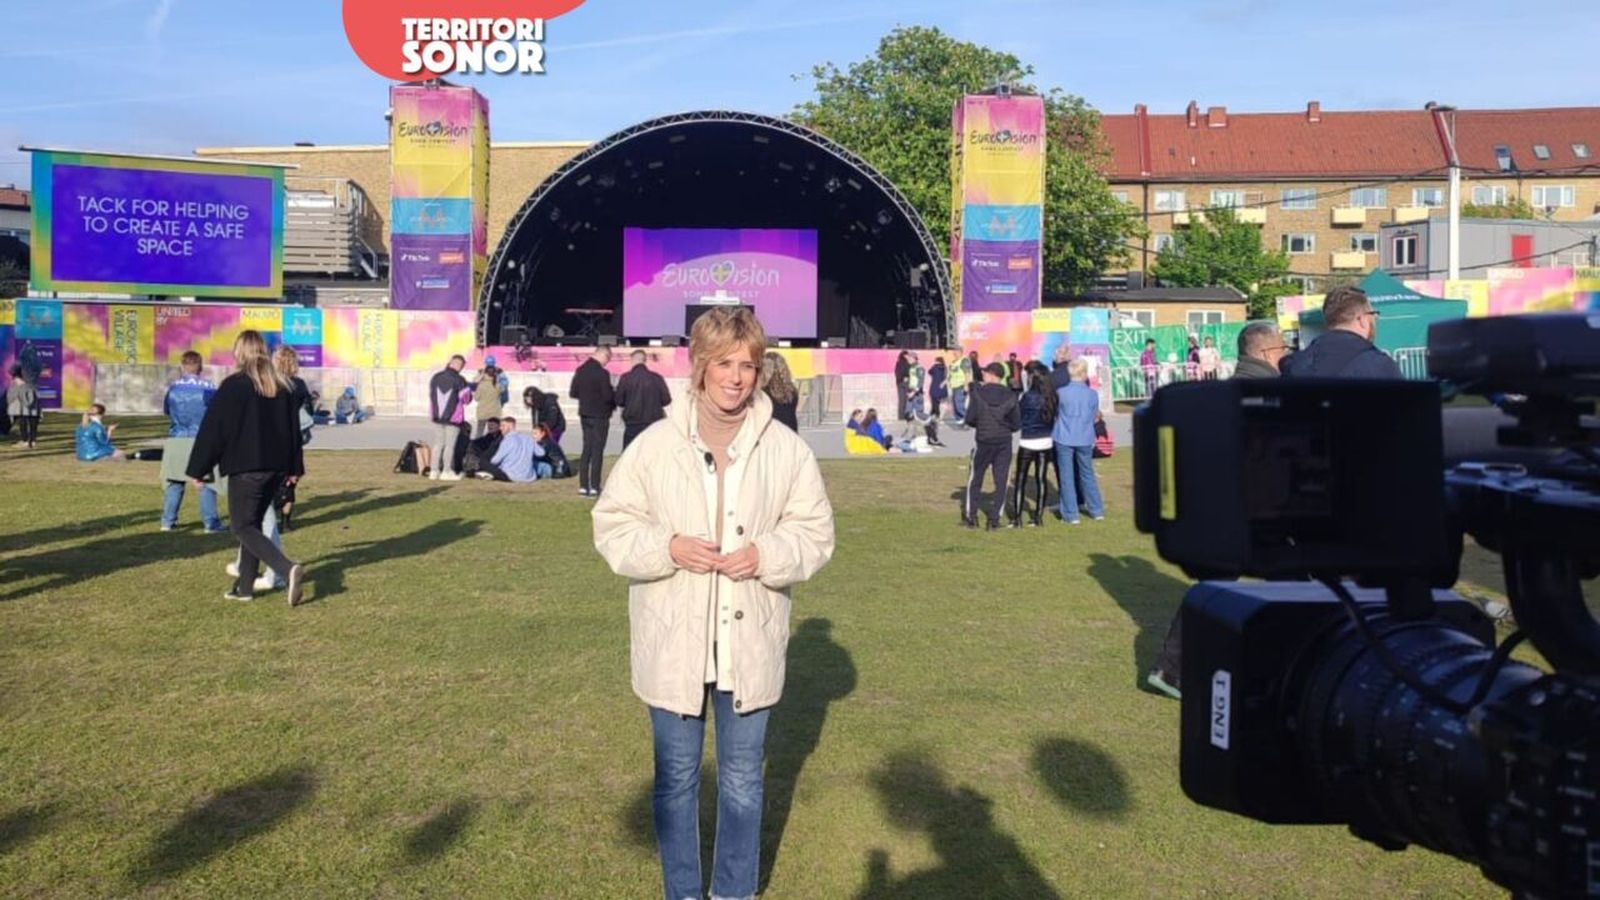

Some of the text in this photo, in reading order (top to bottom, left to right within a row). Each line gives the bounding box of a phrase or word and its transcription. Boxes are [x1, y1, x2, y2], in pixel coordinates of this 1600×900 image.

[78, 196, 249, 220] TACK FOR HELPING
[83, 216, 245, 239] TO CREATE A SAFE
[137, 239, 193, 256] SPACE
[1113, 330, 1150, 345] EXIT
[1215, 696, 1225, 740] ENG
